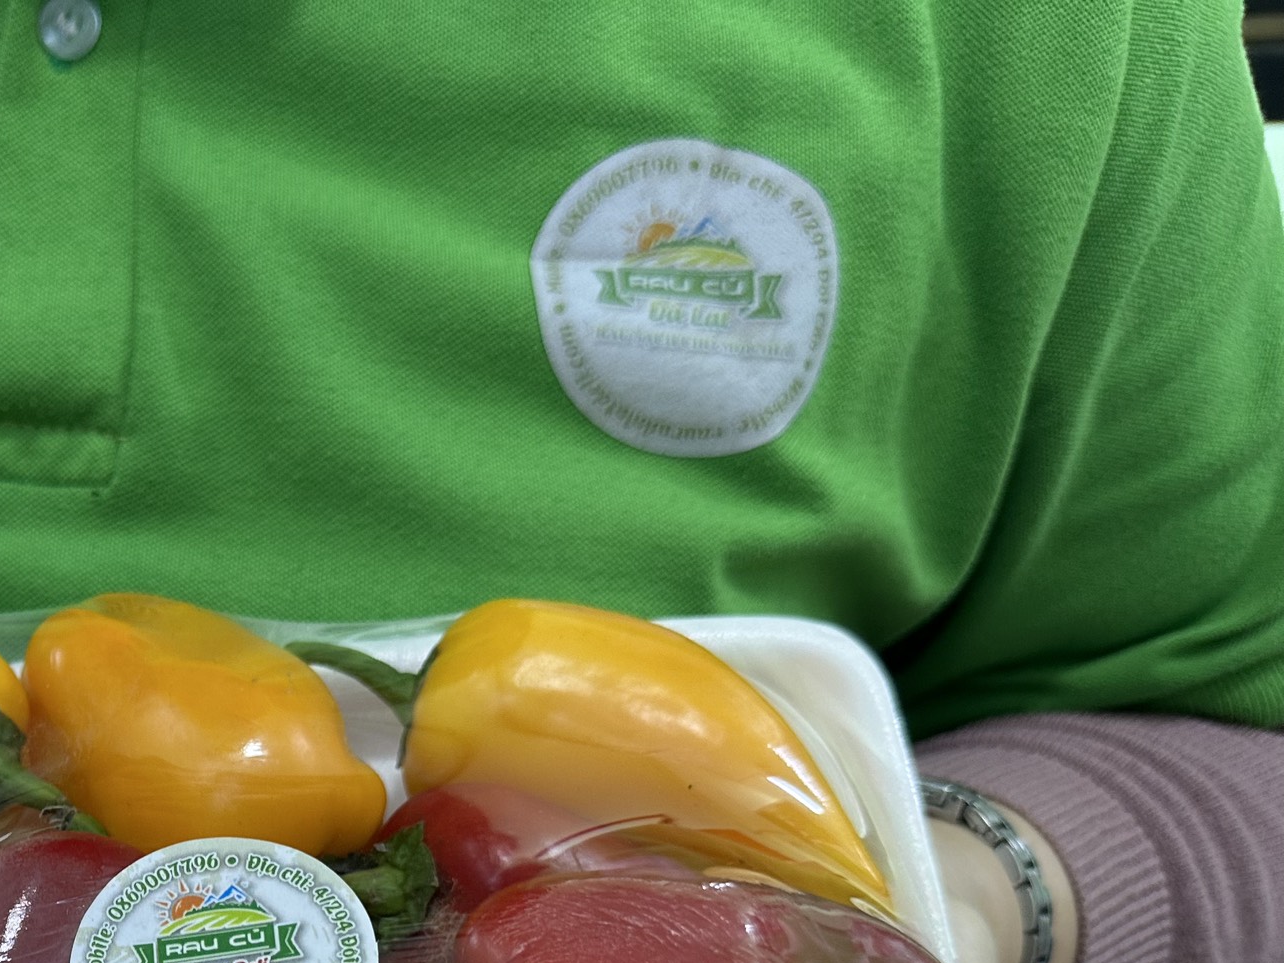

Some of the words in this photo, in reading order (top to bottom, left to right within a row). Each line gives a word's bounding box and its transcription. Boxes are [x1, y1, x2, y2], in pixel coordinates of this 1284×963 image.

[107, 853, 219, 922] 0869007796
[247, 854, 279, 876] Địa
[314, 887, 354, 933] 4/294
[166, 938, 218, 957] RAU
